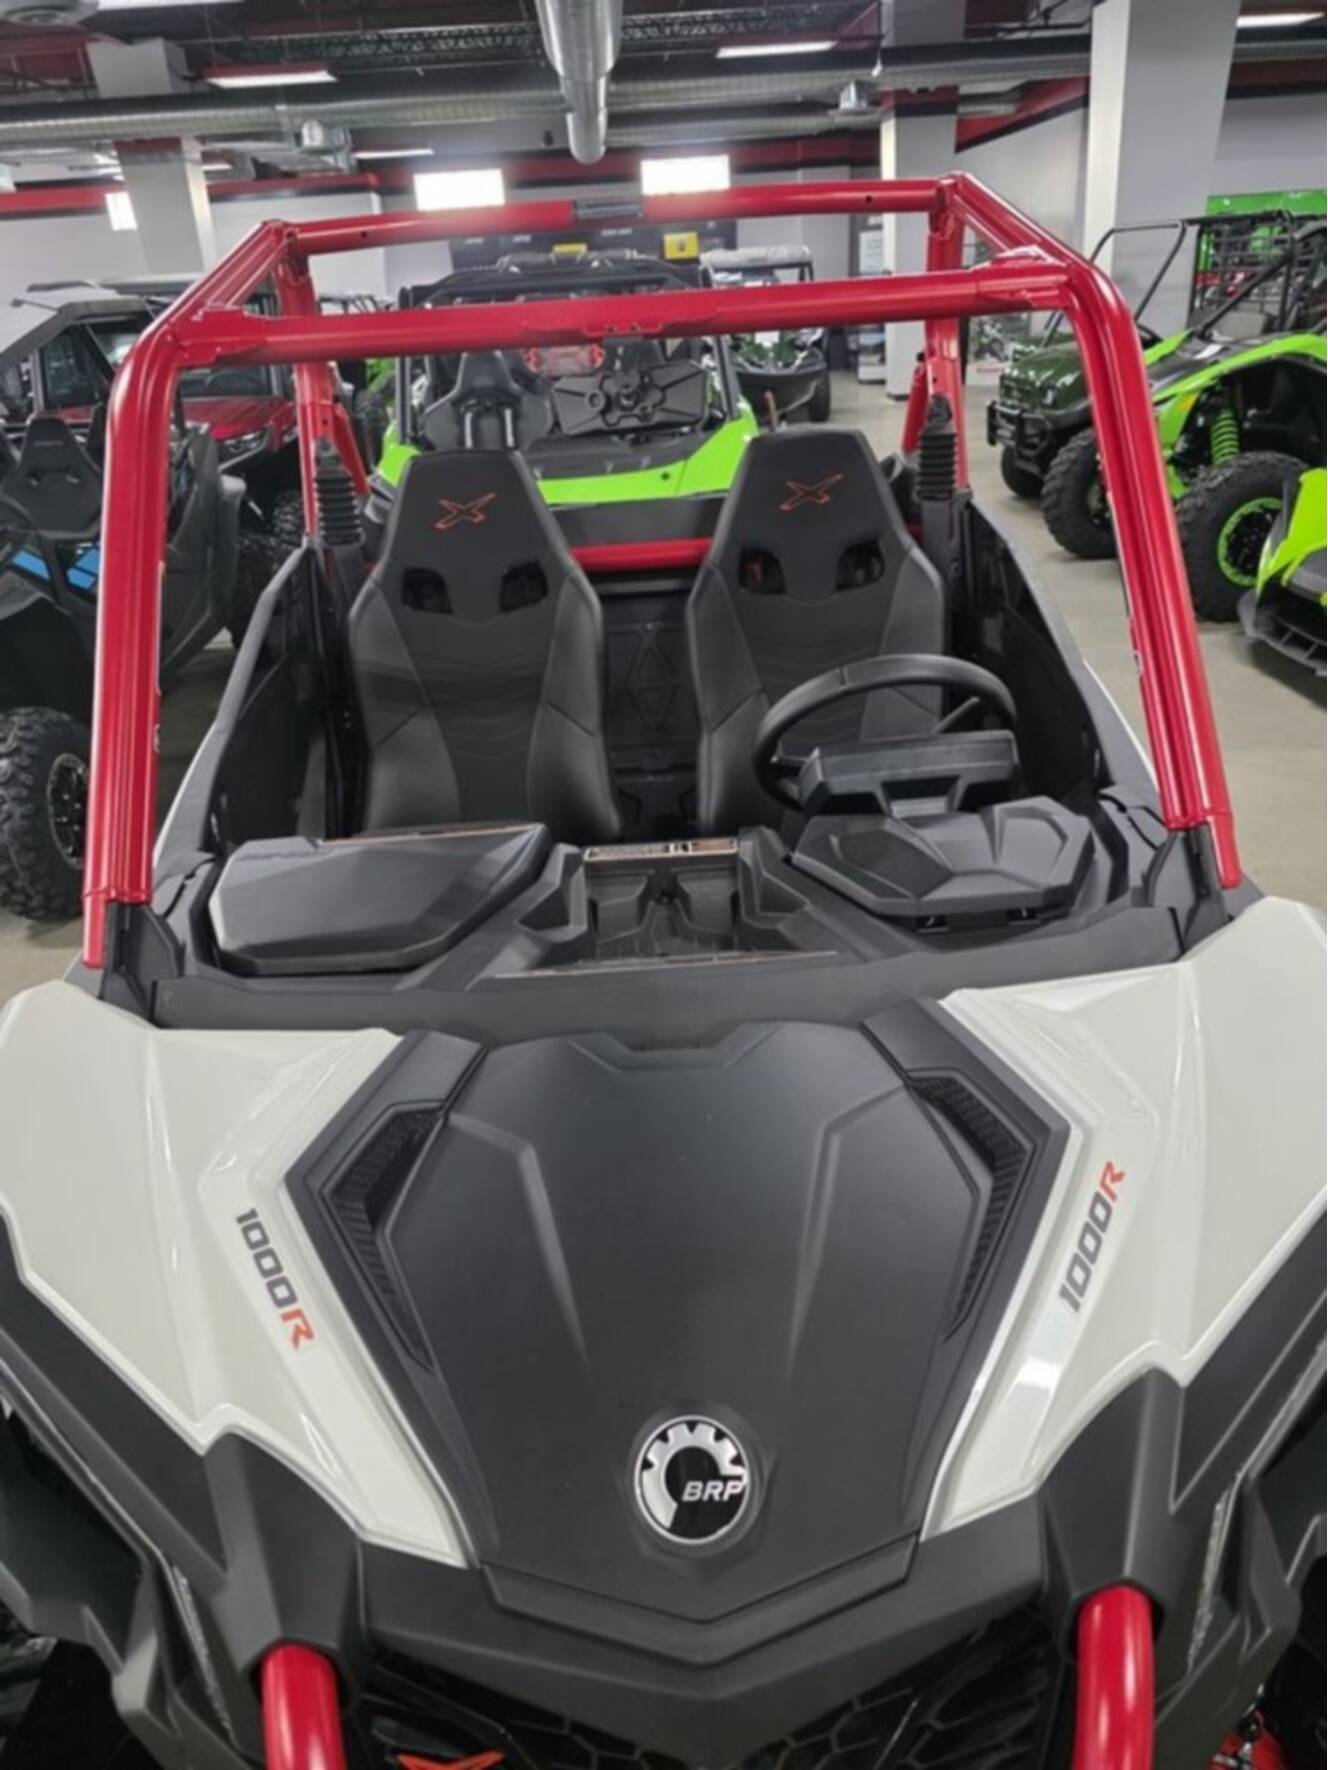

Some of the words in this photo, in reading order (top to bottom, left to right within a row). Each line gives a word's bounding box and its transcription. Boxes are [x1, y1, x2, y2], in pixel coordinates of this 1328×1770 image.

[236, 1208, 315, 1350] 1000R
[1059, 1161, 1125, 1313] 1000R
[682, 1481, 743, 1501] BRP
